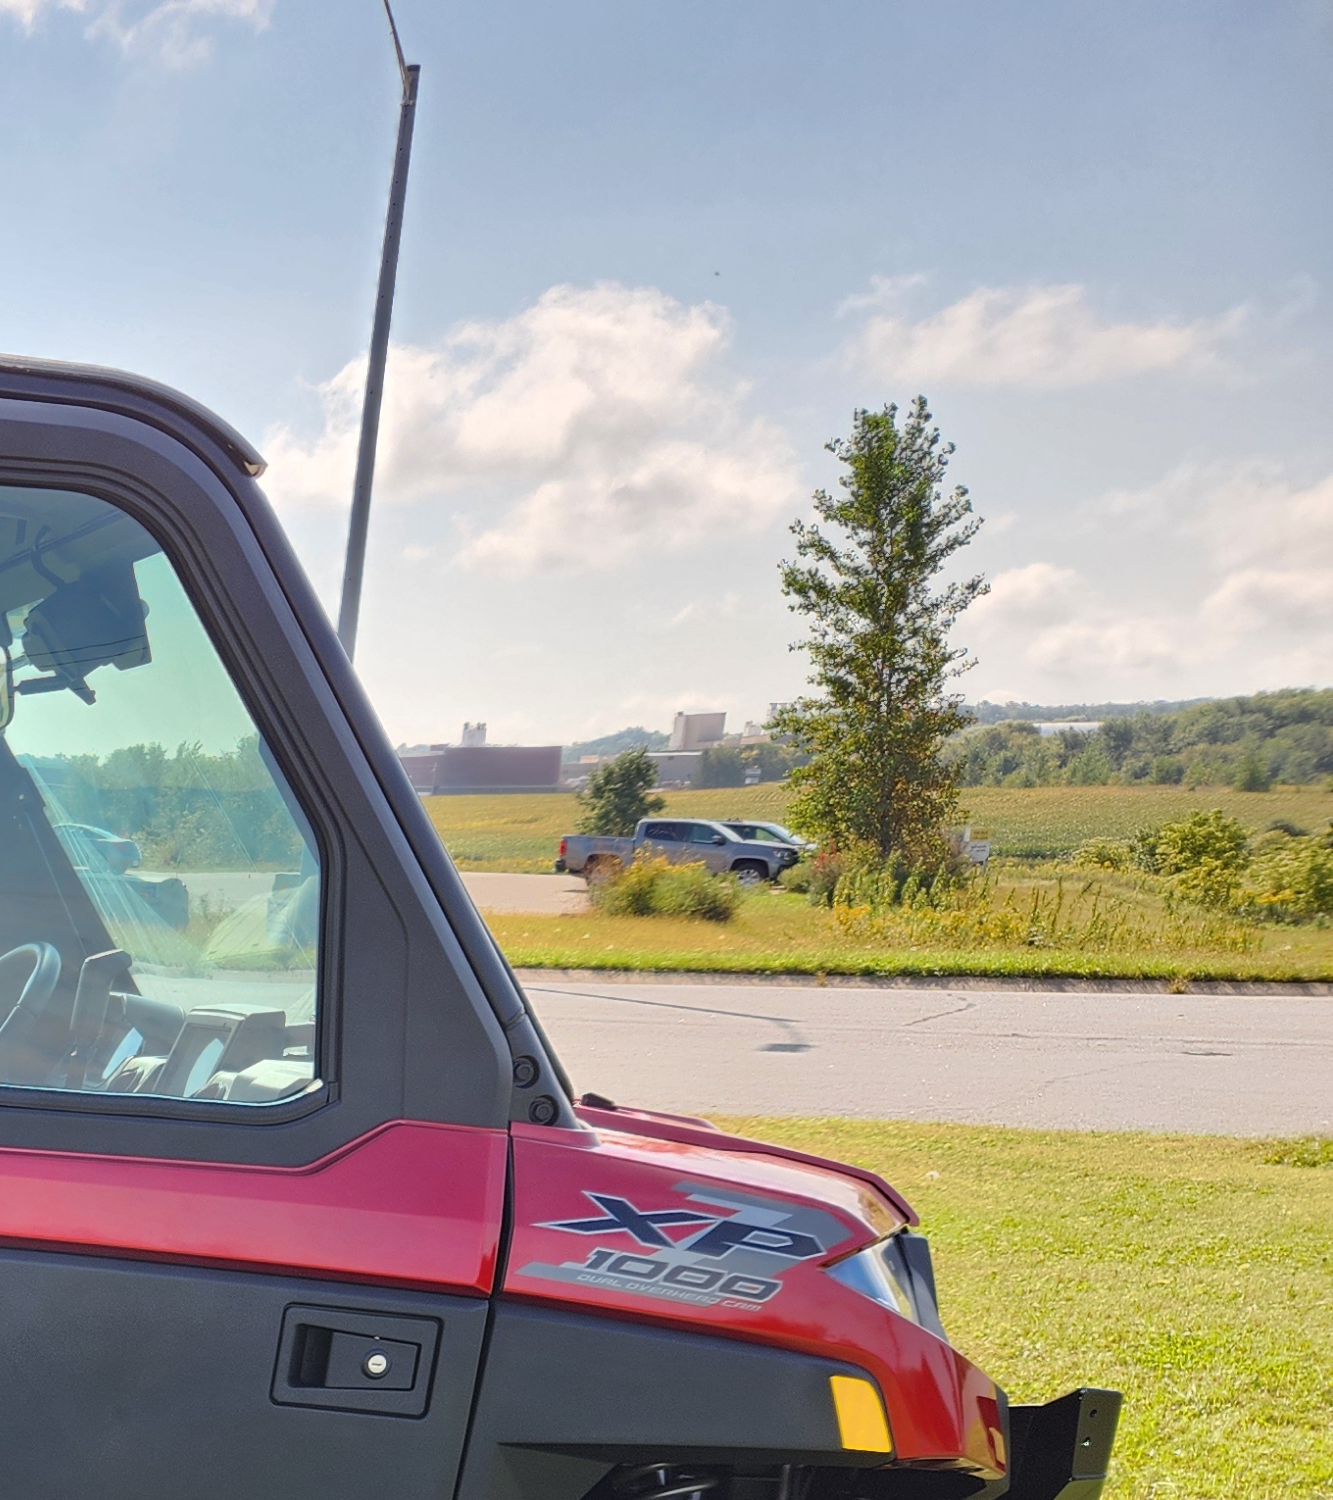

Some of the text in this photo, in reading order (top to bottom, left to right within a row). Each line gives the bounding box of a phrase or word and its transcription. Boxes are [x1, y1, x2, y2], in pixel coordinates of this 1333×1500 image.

[530, 1190, 827, 1260] XP
[576, 1274, 762, 1312] DUAL OVERHEAD CAM
[583, 1246, 783, 1303] 1000
